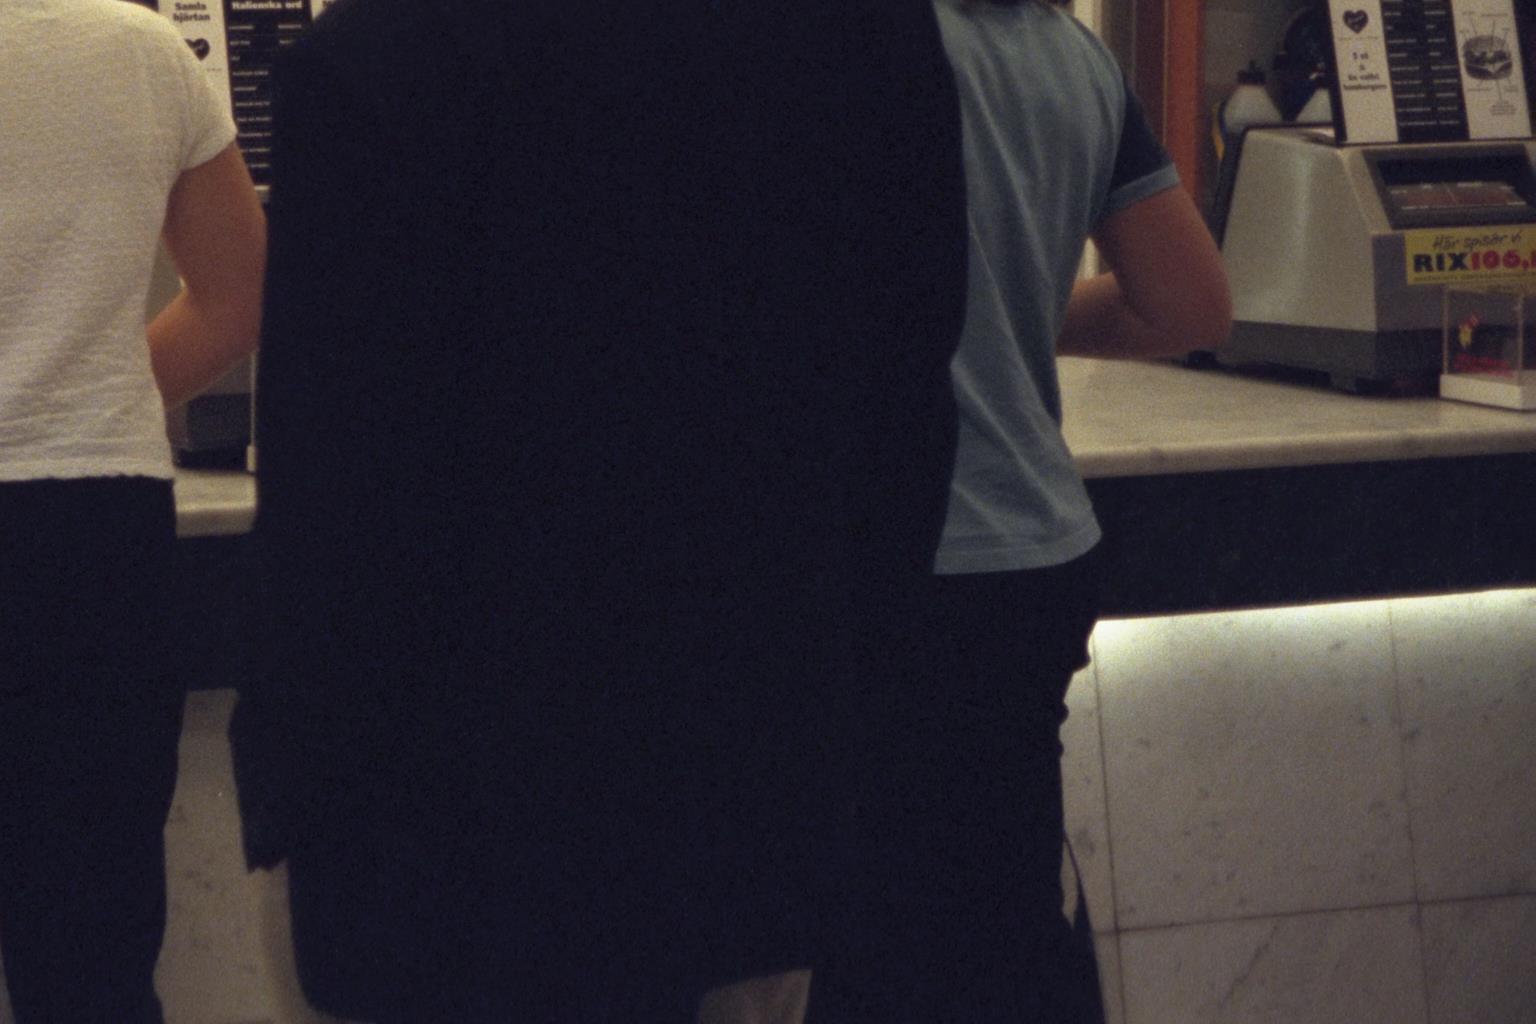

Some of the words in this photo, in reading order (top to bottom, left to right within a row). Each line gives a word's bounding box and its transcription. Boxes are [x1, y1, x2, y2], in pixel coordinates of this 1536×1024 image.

[175, 1, 207, 11] Samla
[285, 0, 303, 9] ord
[173, 12, 211, 23] hjärtan
